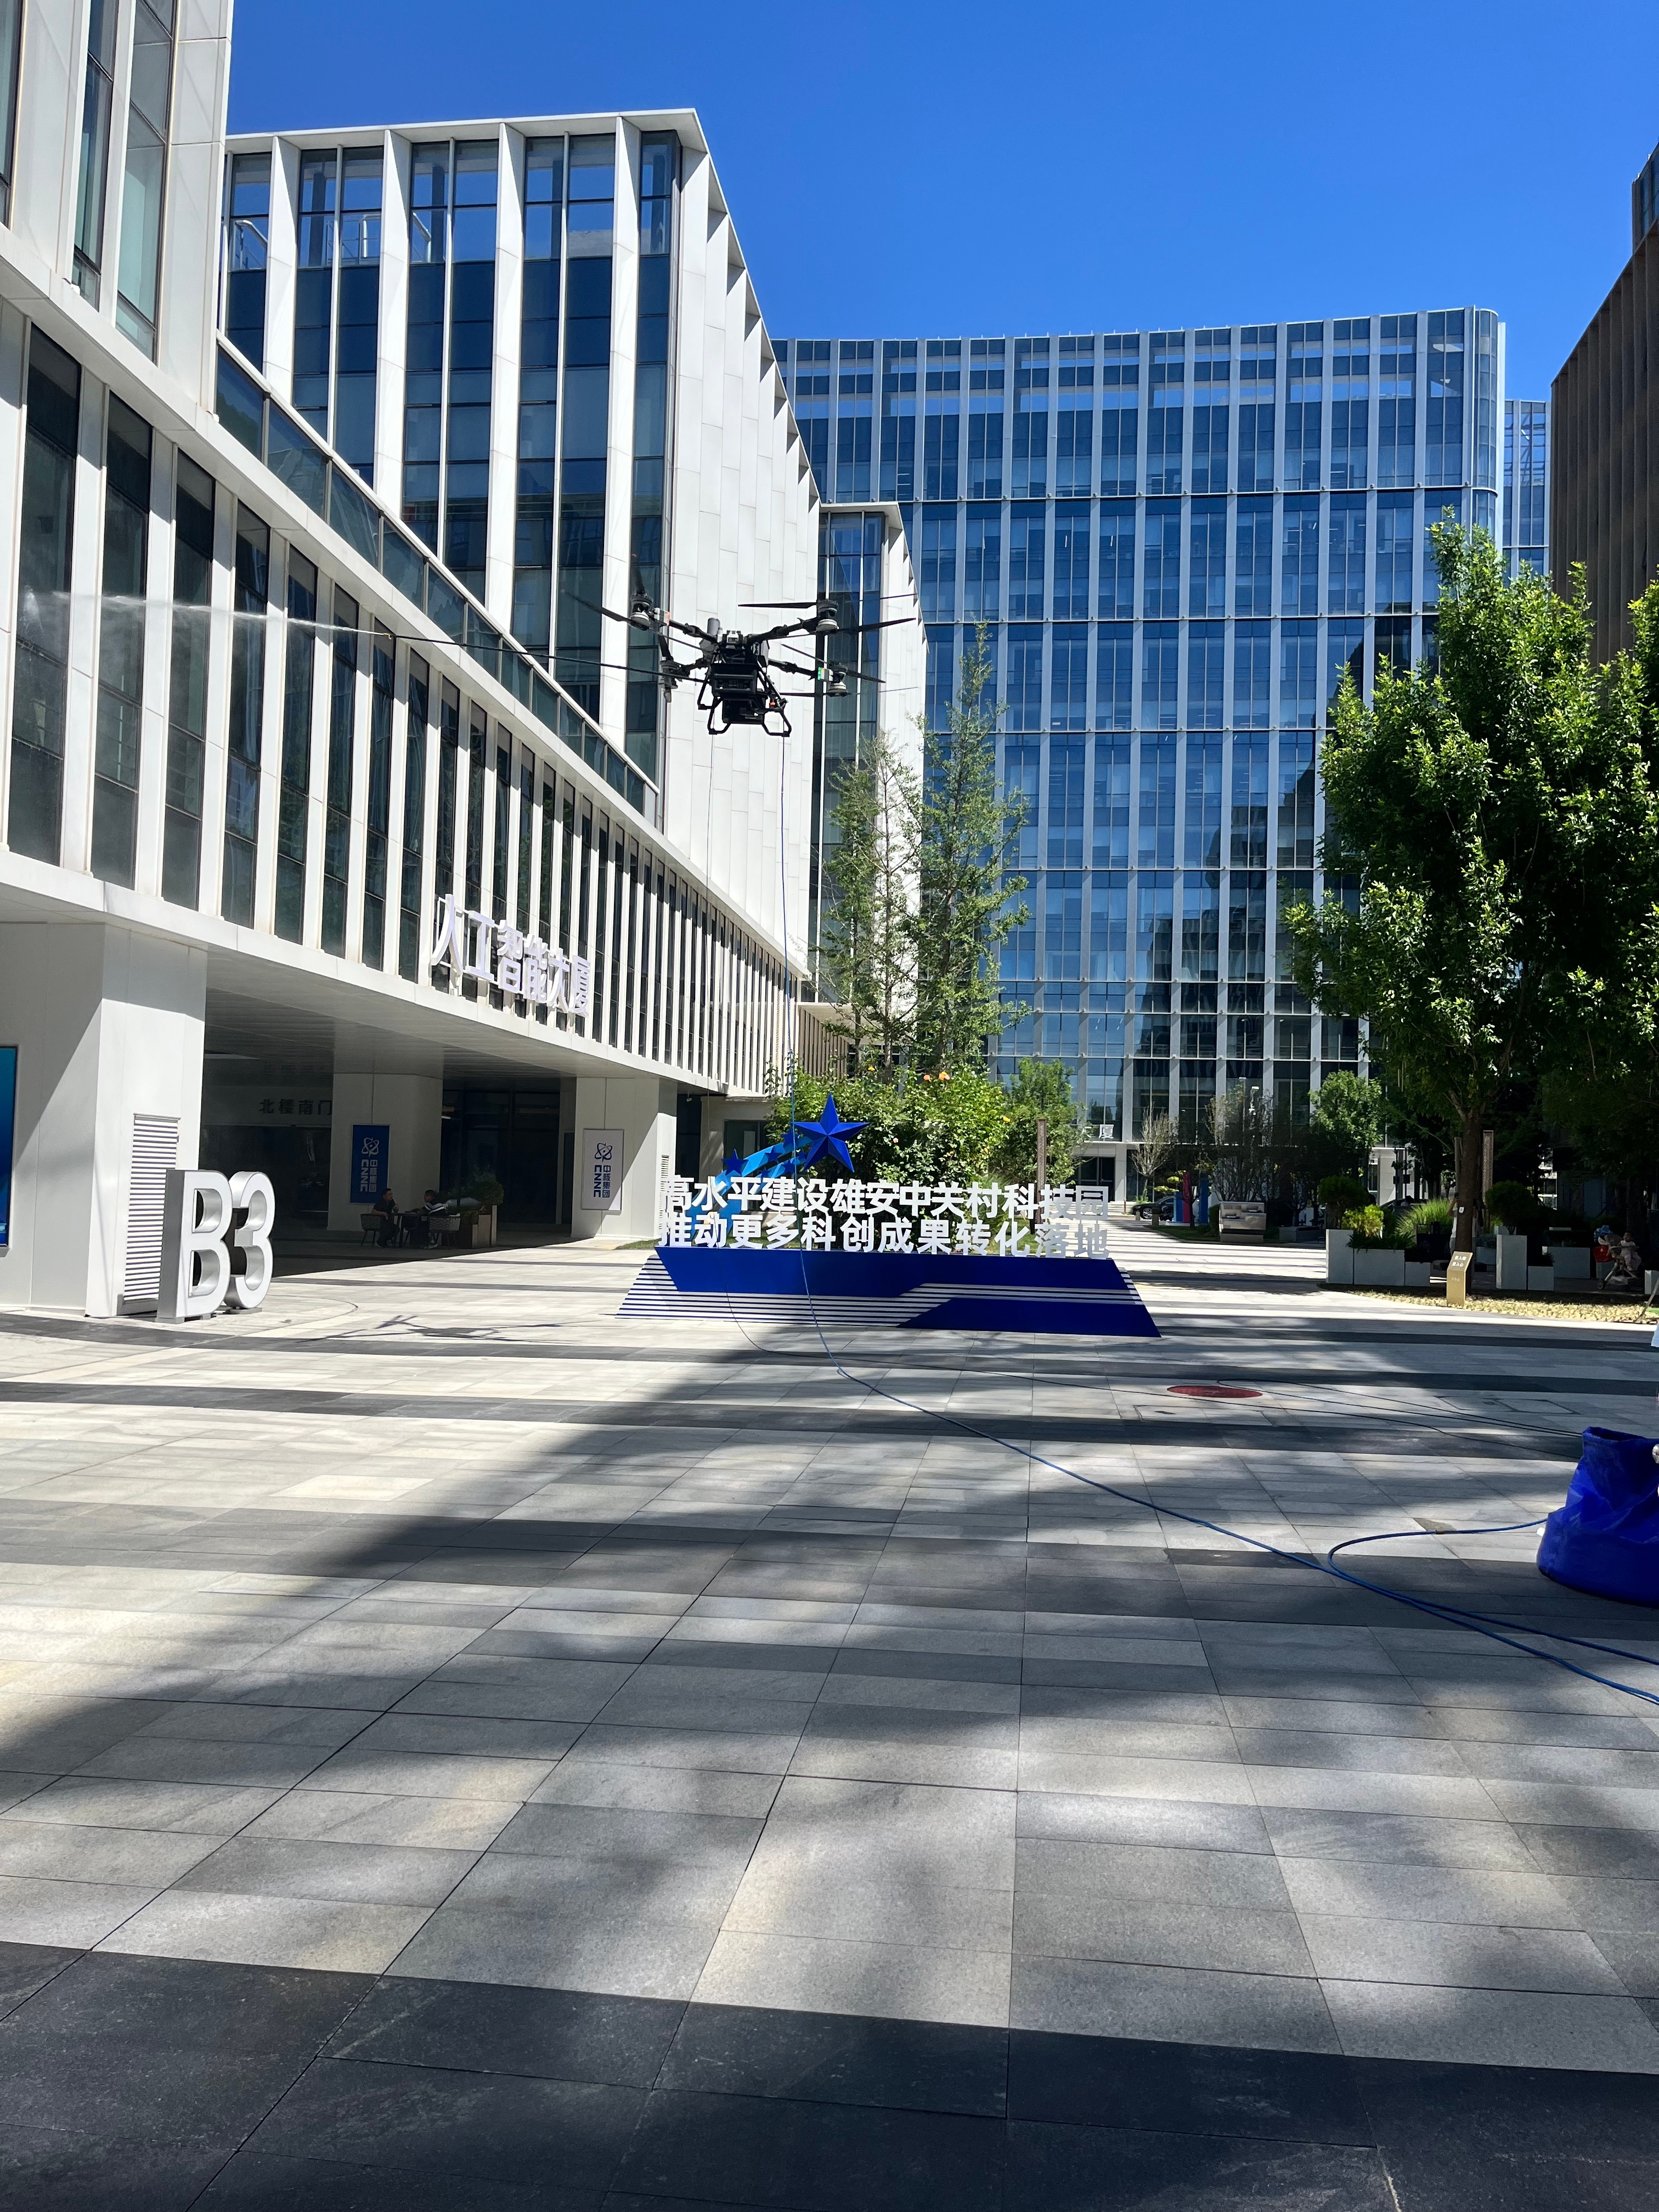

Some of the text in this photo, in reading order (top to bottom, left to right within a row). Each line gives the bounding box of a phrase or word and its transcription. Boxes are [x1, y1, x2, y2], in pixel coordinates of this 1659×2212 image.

[431, 894, 591, 1017] 人工智能大厦
[259, 1098, 332, 1115] 北楼南门
[360, 1159, 369, 1192] CNNC
[369, 1159, 378, 1193] 中核集团
[594, 1165, 602, 1198] CNNC
[602, 1165, 611, 1198] 中核集团
[661, 1174, 1109, 1221] 高水平建设雄安中关村科技园
[159, 1169, 275, 1318] B3
[658, 1209, 1110, 1260] 推动更多科创成果转化落地
